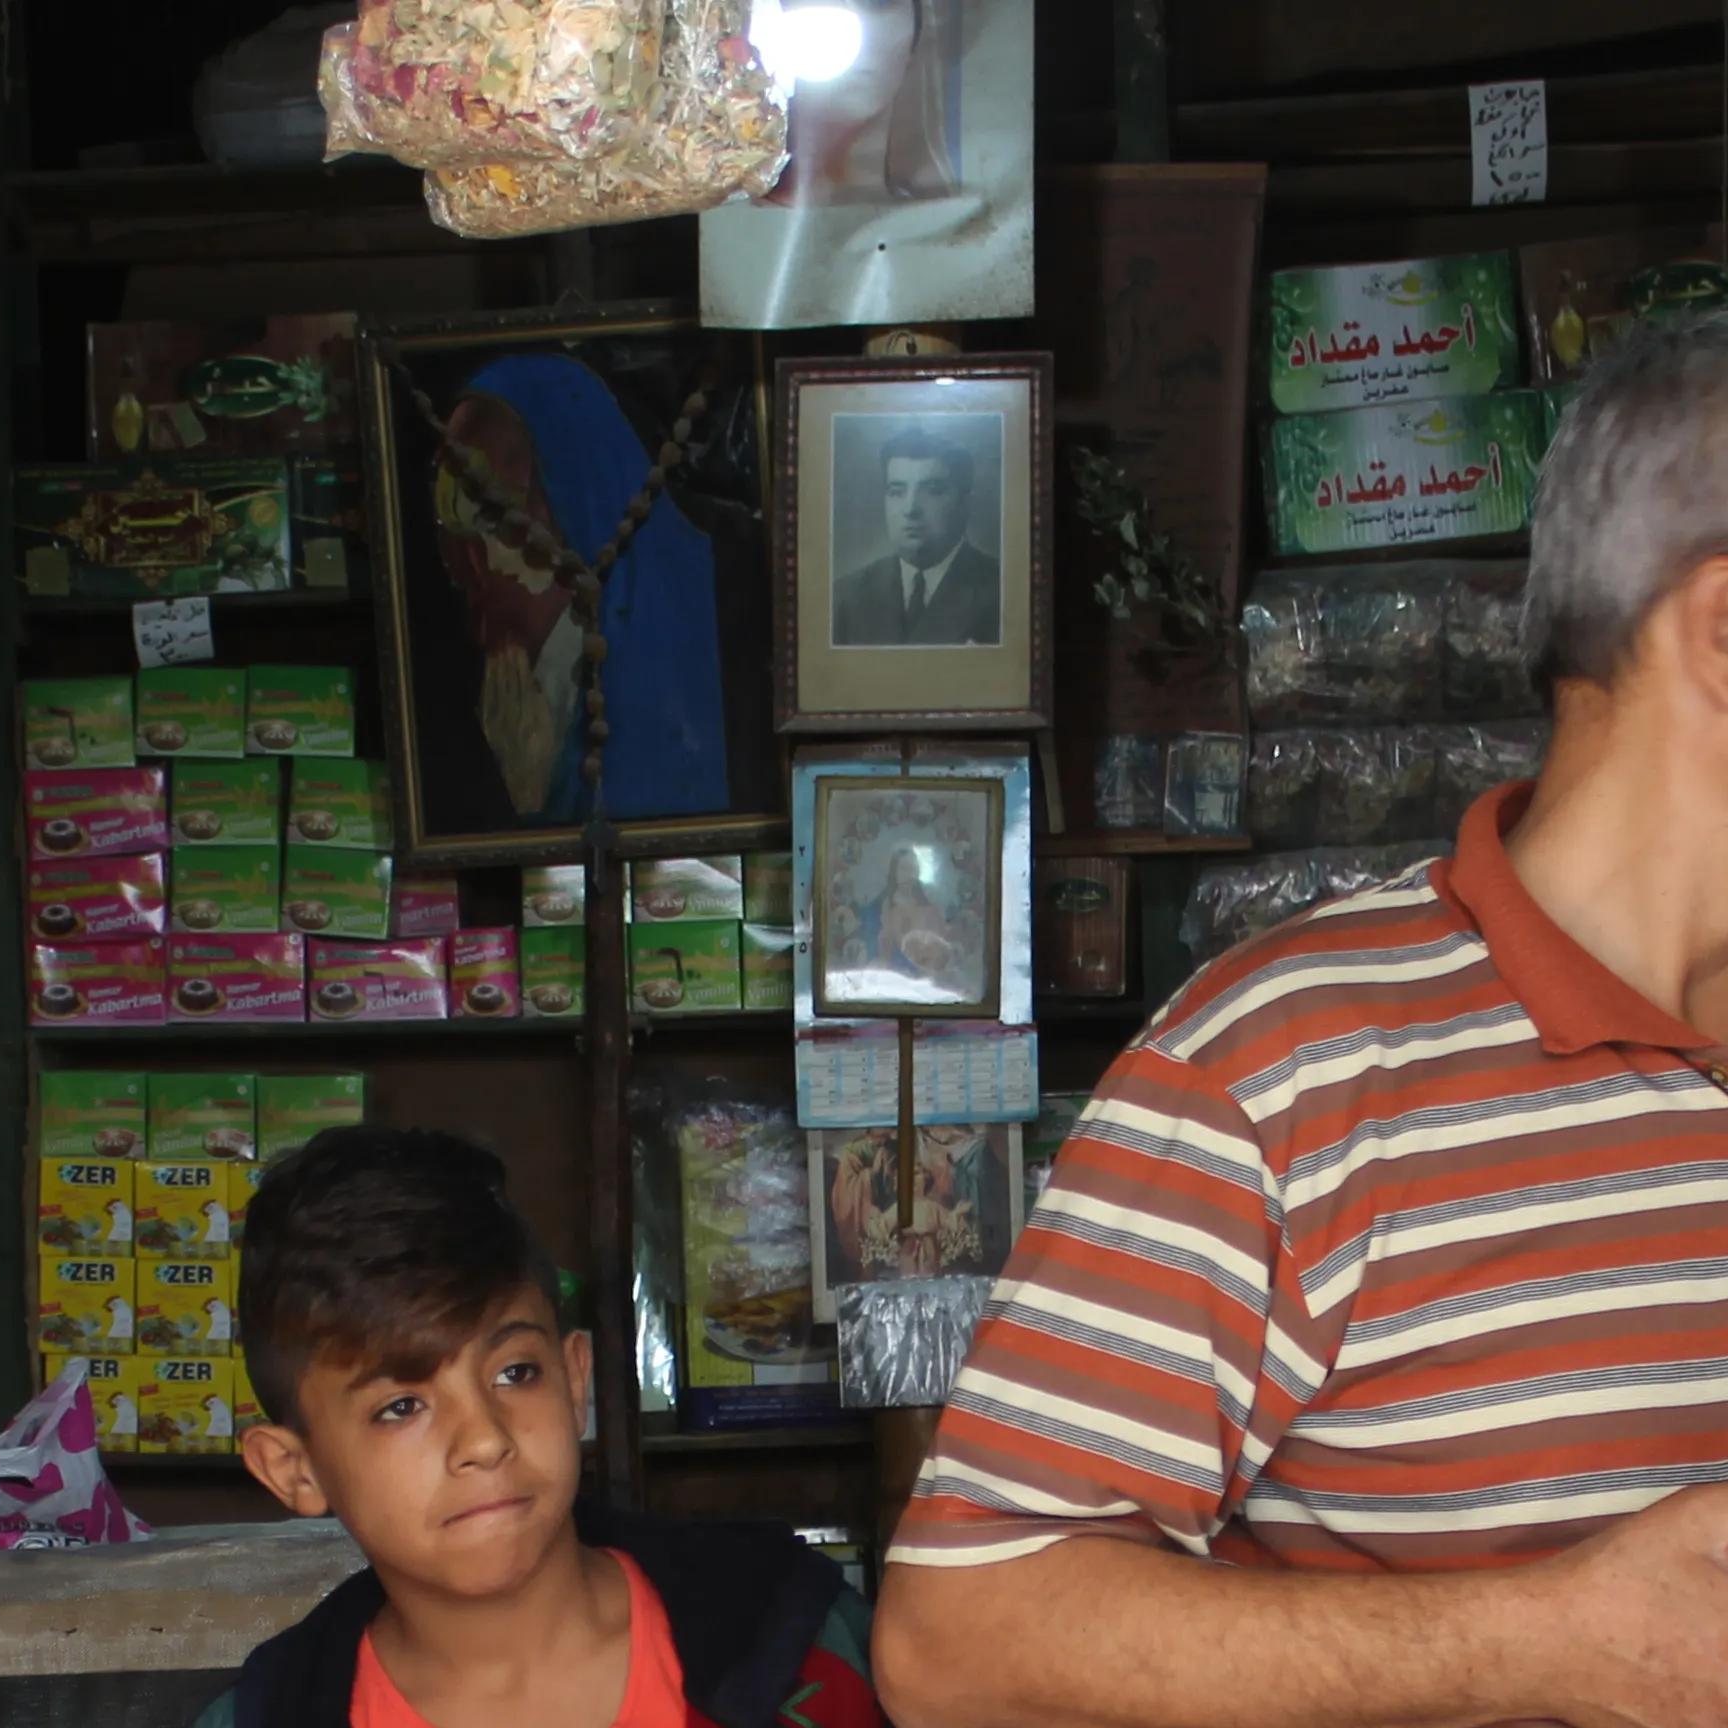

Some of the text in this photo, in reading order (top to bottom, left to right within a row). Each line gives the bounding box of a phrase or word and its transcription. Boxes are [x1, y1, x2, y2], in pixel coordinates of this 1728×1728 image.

[1289, 303, 1476, 368] أحمد مقداد
[1317, 441, 1502, 508] أحمد مقداد
[91, 821, 166, 849] Kabartma
[85, 909, 160, 935] Kabart
[86, 993, 163, 1016] Kabartma
[226, 989, 301, 1012] Kabartma
[366, 986, 442, 1012] Kabartma
[70, 1165, 117, 1185] ZER
[165, 1167, 212, 1187] ZER
[70, 1263, 116, 1282] ZER
[167, 1265, 214, 1284] ZER
[83, 1359, 119, 1378] ER
[166, 1361, 212, 1381] ZER
